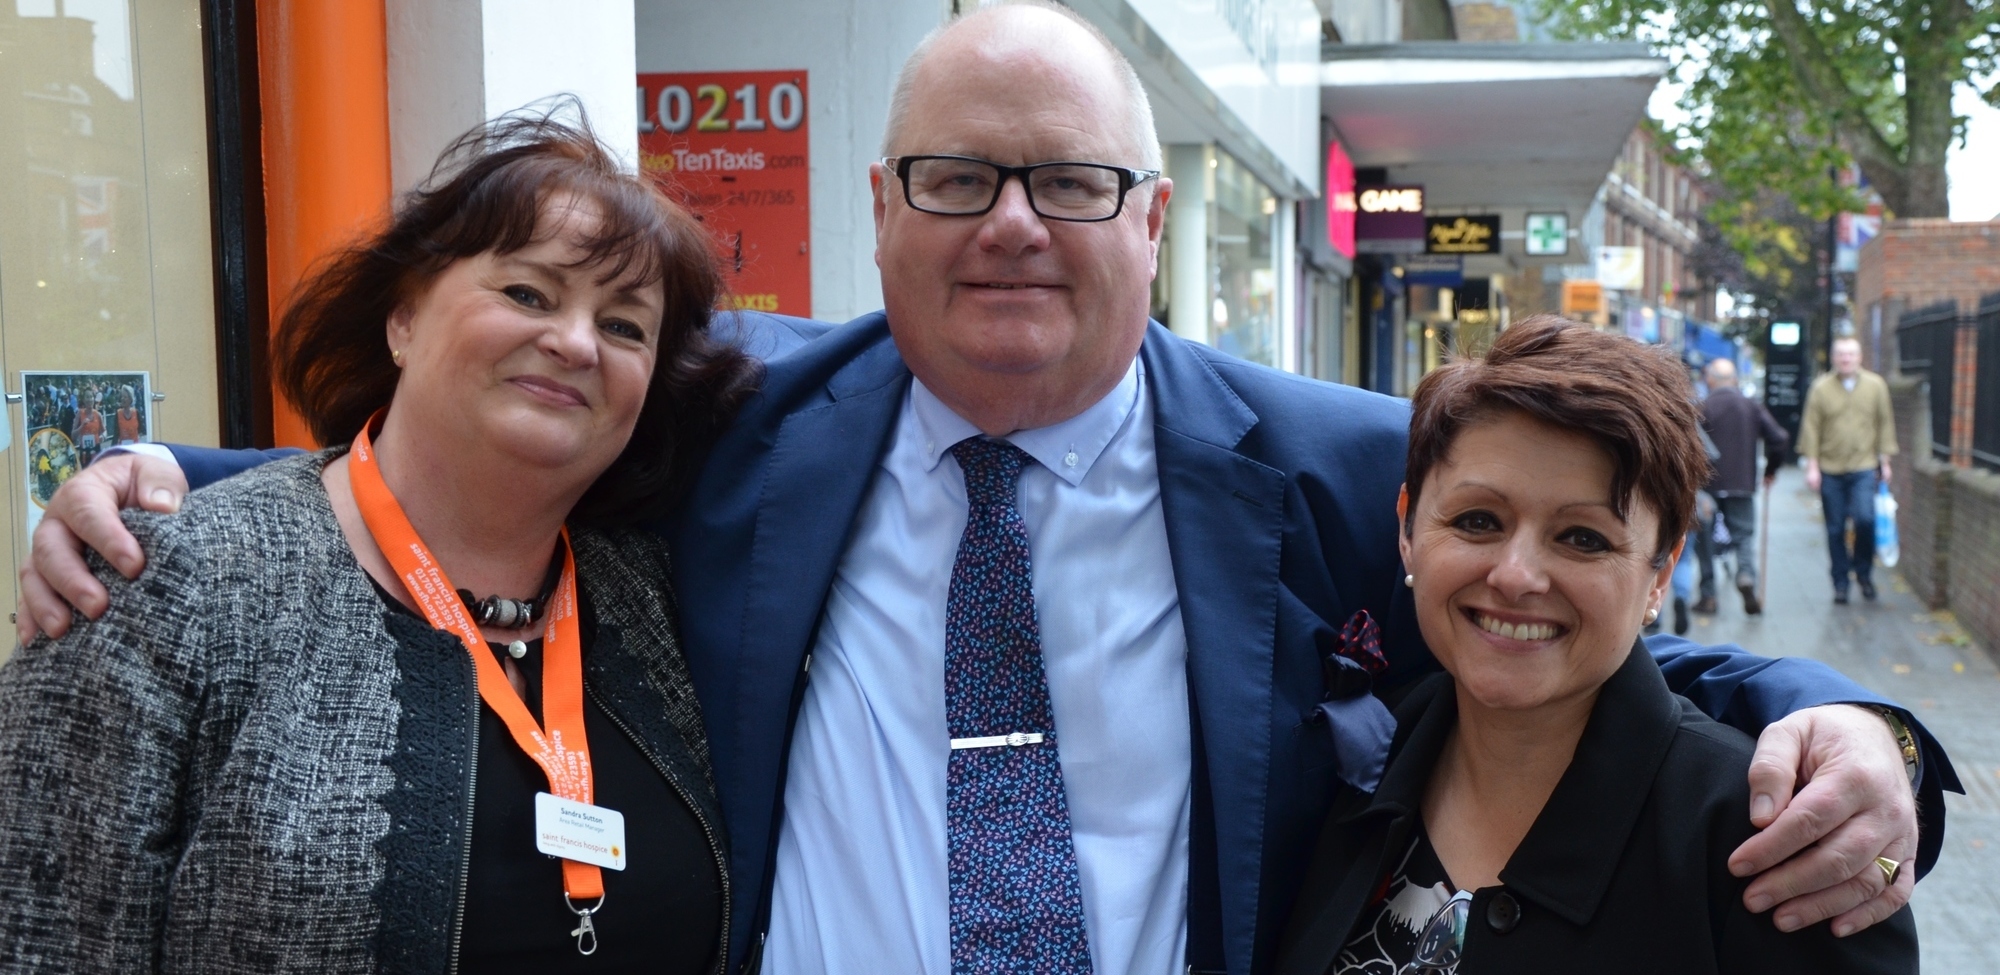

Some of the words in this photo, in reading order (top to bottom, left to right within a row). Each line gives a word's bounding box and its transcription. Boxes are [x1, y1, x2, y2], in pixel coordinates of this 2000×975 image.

[1360, 189, 1423, 213] GAME
[410, 543, 431, 568] saint
[427, 567, 454, 603] francis
[450, 602, 478, 645] hospice
[415, 567, 436, 594] 01708
[432, 594, 456, 627] 723593
[560, 807, 582, 819] Sandra
[582, 813, 603, 824] Sutton
[542, 833, 558, 842] saint
[560, 835, 583, 848] francis
[583, 842, 608, 854] hospice
